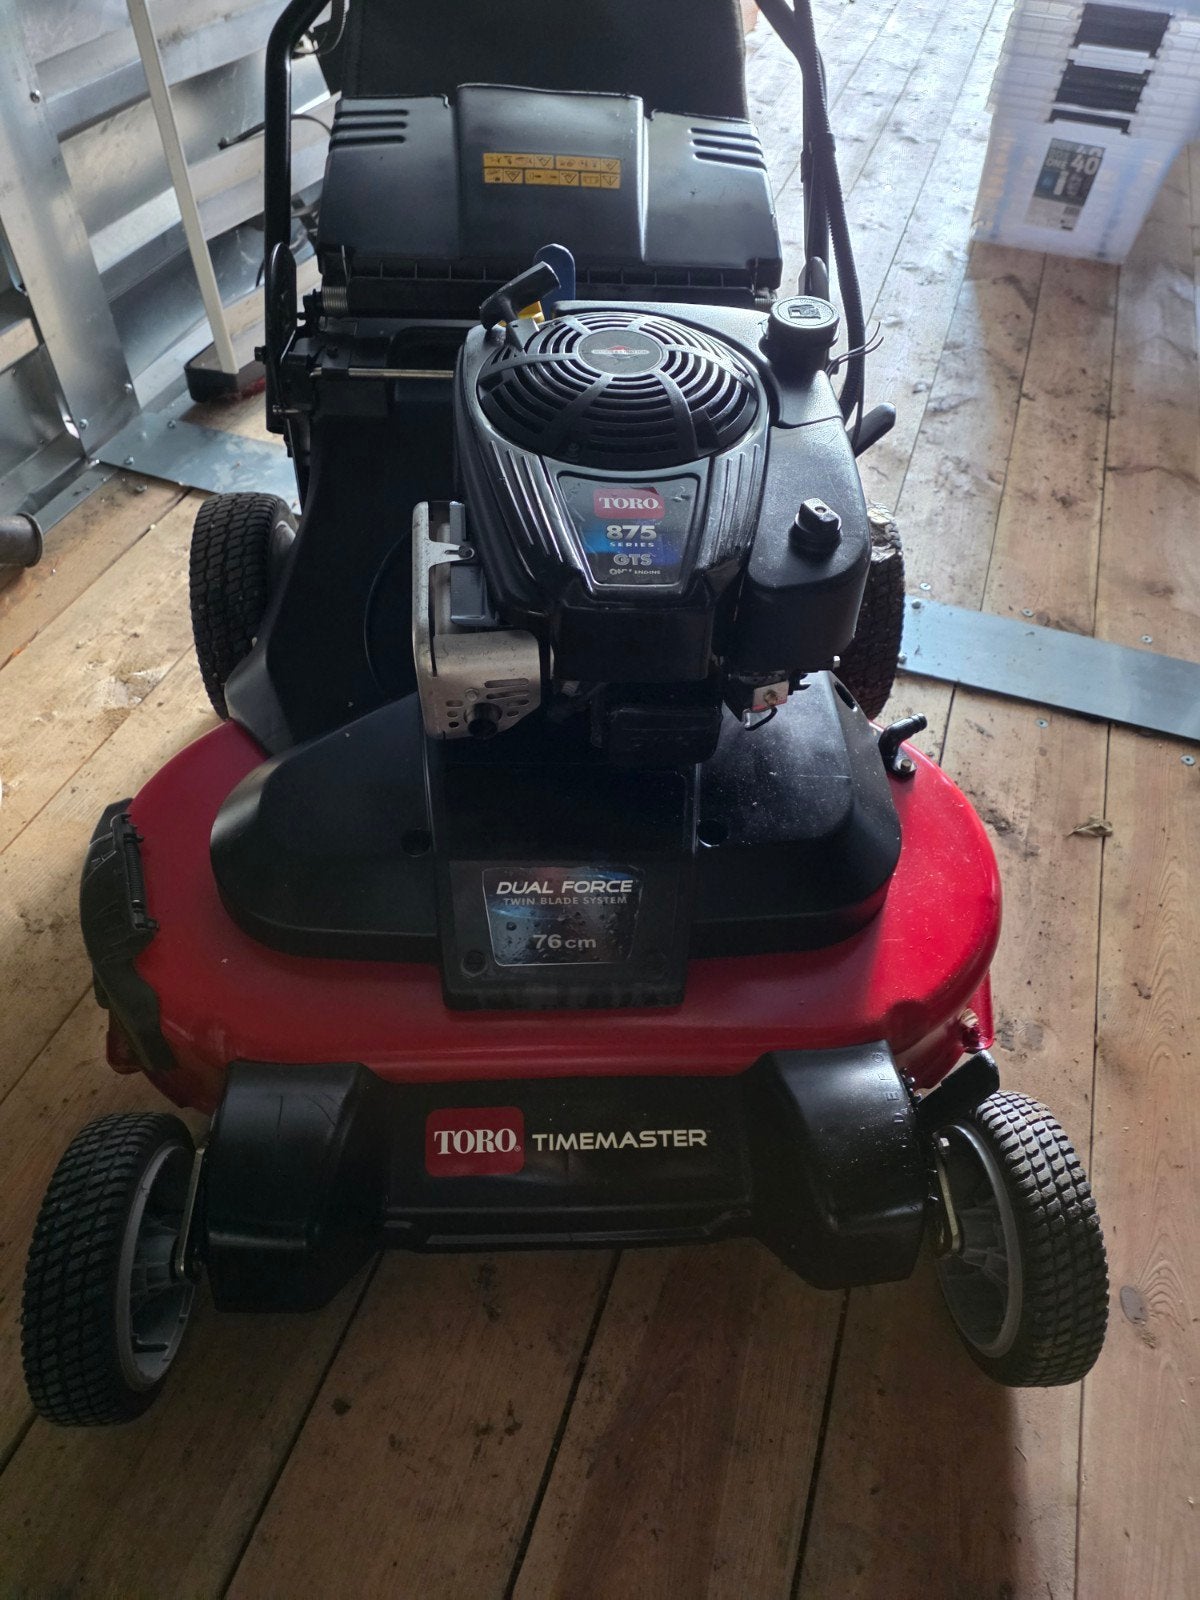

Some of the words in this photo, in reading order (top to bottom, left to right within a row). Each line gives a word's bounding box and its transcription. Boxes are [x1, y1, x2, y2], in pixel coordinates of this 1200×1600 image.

[599, 497, 659, 509] TORO
[606, 525, 657, 540] 875
[613, 553, 653, 566] GTS
[496, 881, 554, 895] DUAL
[561, 880, 634, 893] FORCE
[503, 897, 536, 906] TWIN
[540, 897, 579, 905] BLADE
[583, 896, 628, 904] SYSTEM
[434, 1128, 517, 1155] TORO
[532, 1129, 708, 1151] TIMEMASTER
